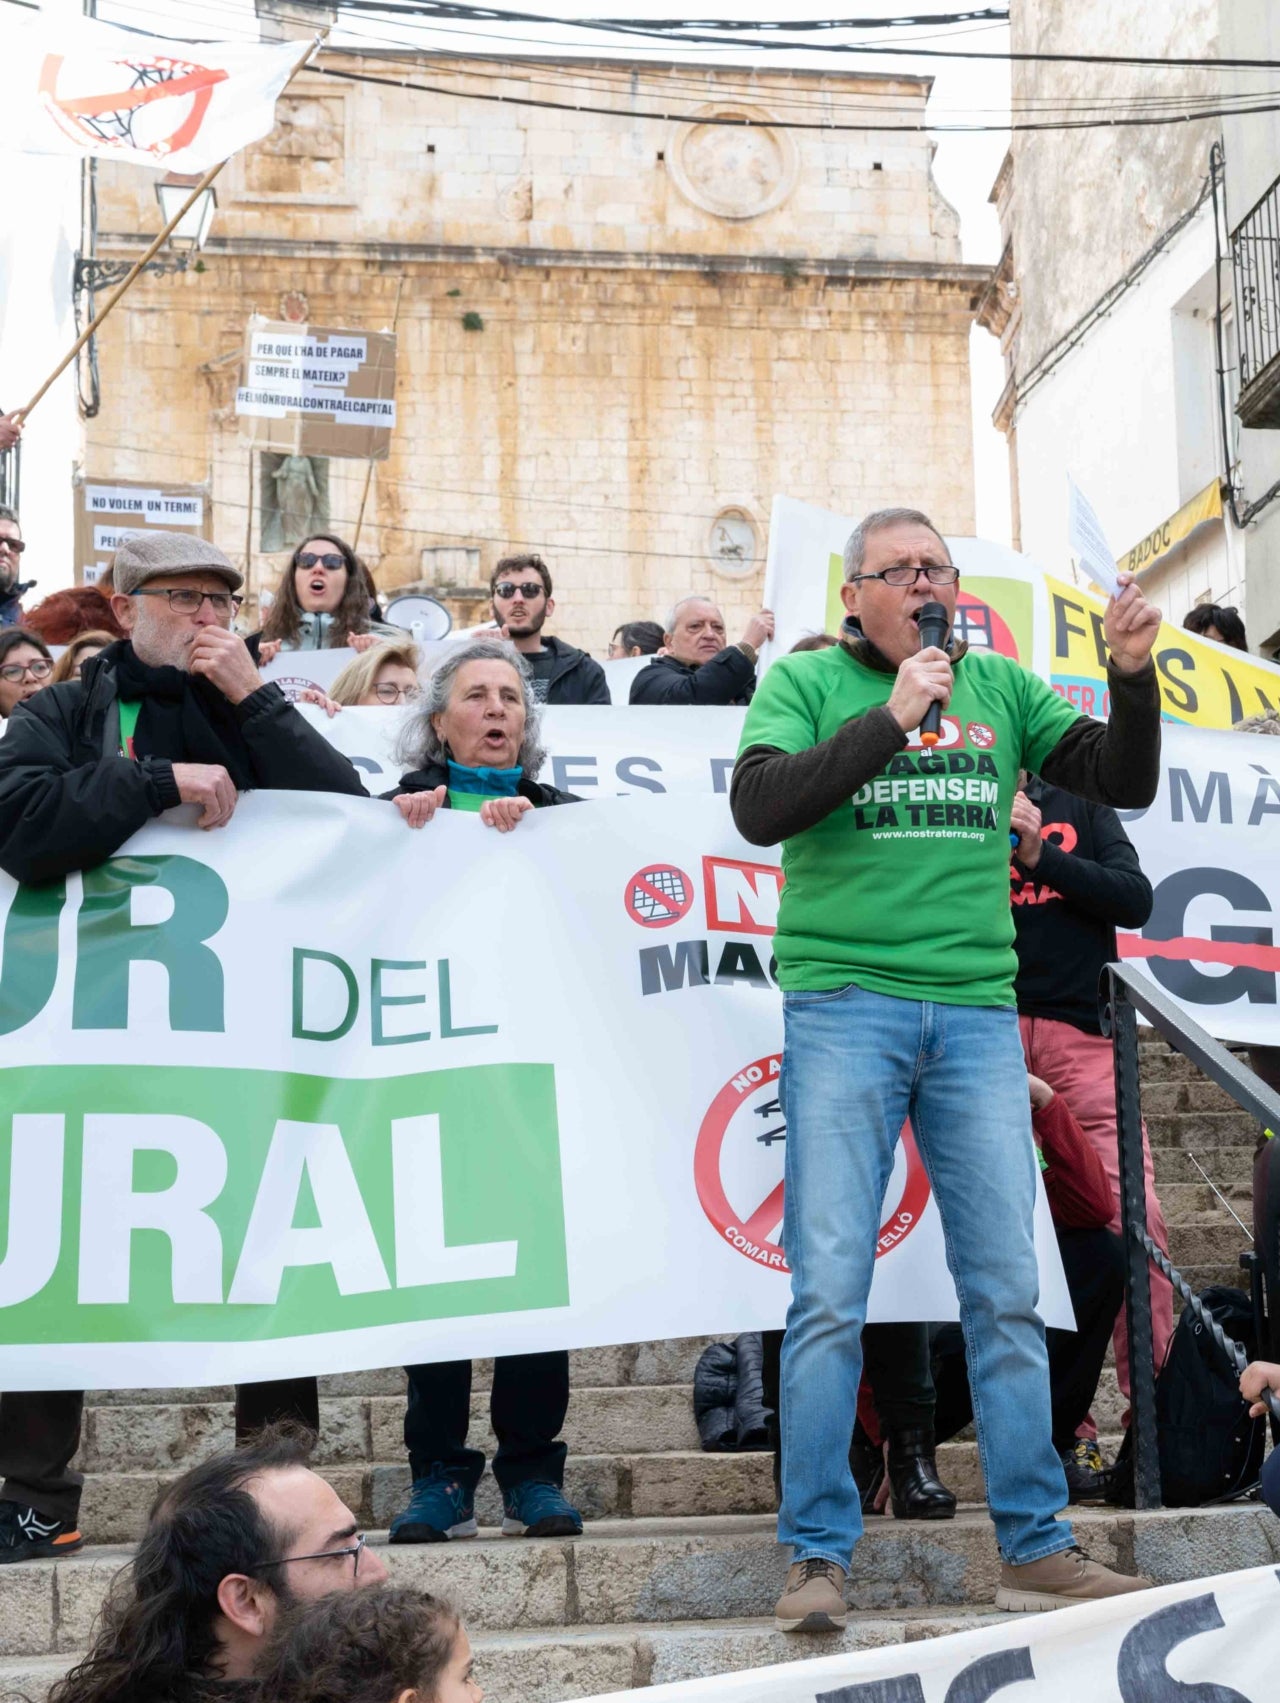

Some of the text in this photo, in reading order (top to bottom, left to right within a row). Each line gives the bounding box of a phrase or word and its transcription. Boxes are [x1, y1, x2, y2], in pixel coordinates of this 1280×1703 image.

[316, 346, 328, 358] DE
[330, 346, 363, 359] PAGAR
[255, 364, 289, 379] SEMPRE
[302, 369, 346, 382] MATEIX?
[92, 497, 198, 513] NO VOLEM UN TERME
[1128, 520, 1171, 571] BADOC
[876, 752, 999, 778] AGDA
[920, 747, 933, 757] al
[852, 778, 999, 806] DEFENSEM
[855, 804, 997, 831] LA TERRA
[872, 829, 985, 842] www.nostraterra.org
[292, 947, 499, 1046] DEL
[731, 1066, 763, 1094] NO
